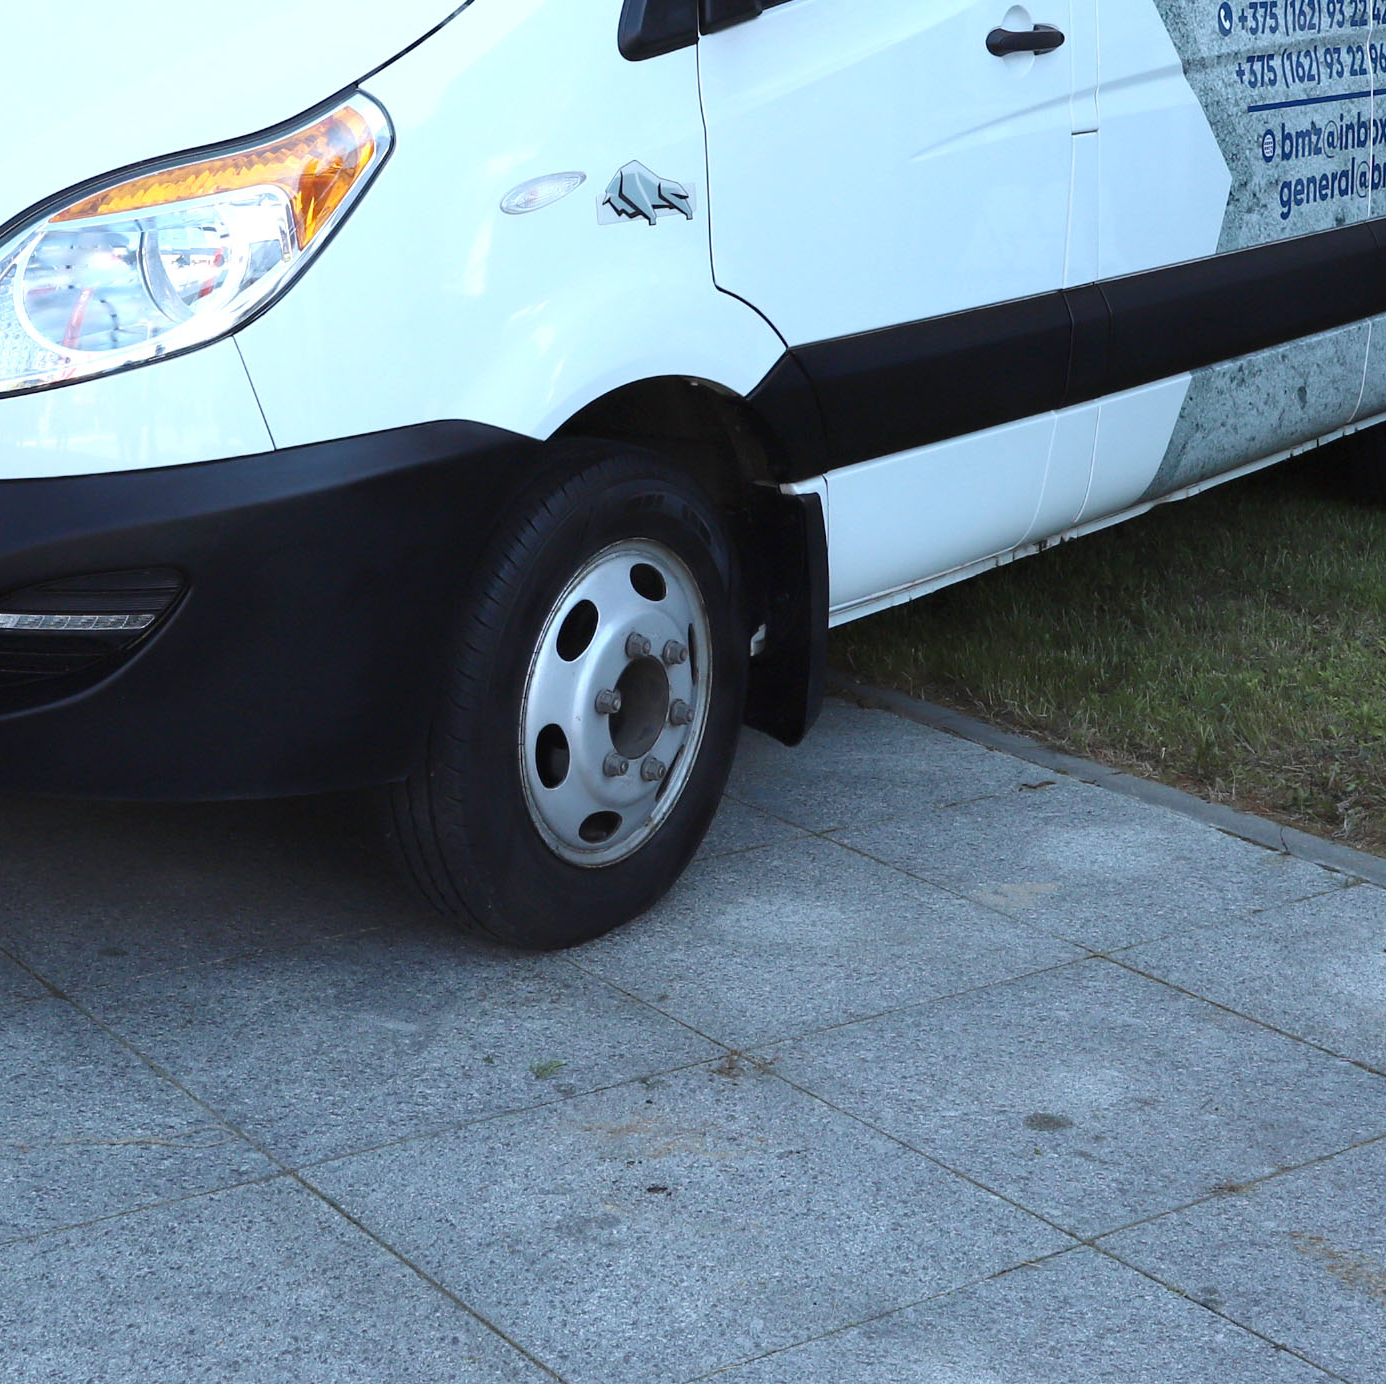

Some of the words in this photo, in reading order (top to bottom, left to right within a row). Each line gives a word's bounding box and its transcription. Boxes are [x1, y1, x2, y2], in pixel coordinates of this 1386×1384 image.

[1238, 0, 1280, 36] +375
[1235, 53, 1278, 89] +375
[1280, 44, 1321, 89] (162)
[1323, 47, 1345, 80] 93
[1346, 45, 1368, 77] 22
